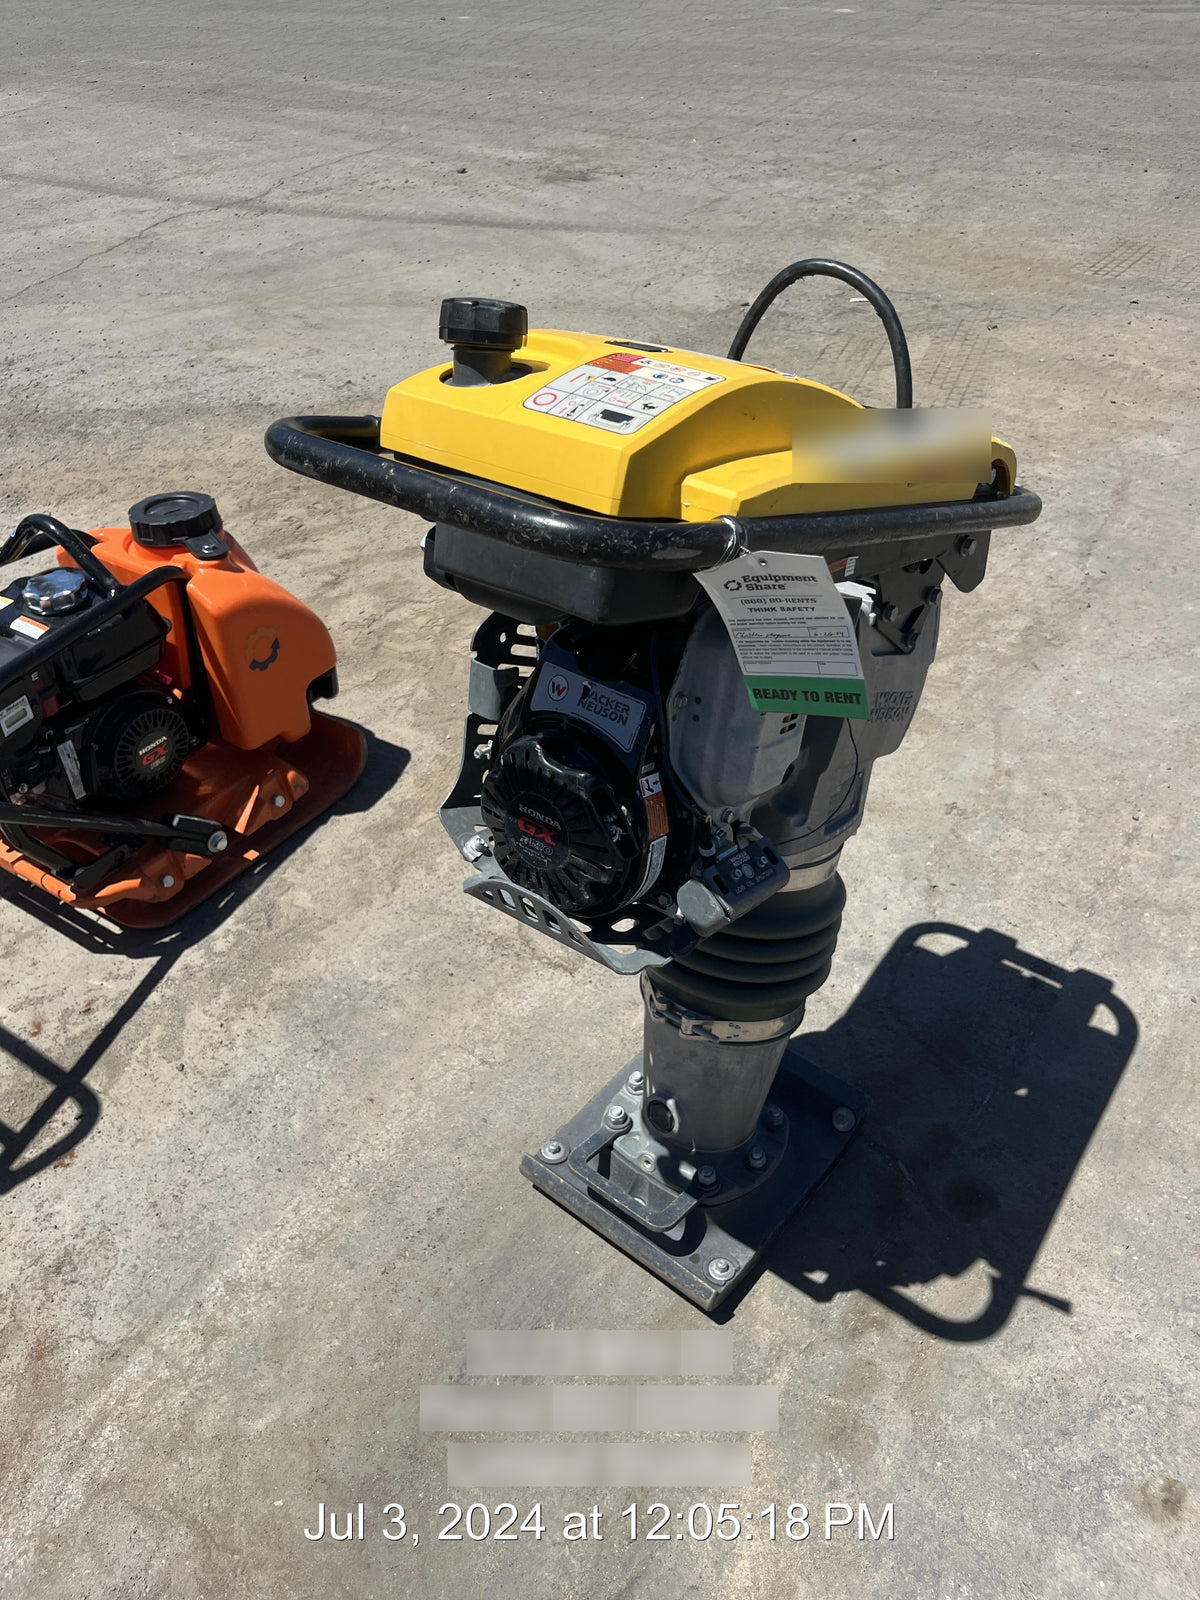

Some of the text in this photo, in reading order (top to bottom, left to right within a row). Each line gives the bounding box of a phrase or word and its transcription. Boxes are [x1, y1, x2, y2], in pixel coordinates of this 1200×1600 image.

[742, 573, 818, 584] Equipment
[745, 582, 786, 591] Share
[780, 605, 816, 613] SAFETY
[582, 686, 631, 716] ACKER
[752, 687, 862, 705] READY TO RENT
[576, 697, 630, 726] NEUSON
[138, 736, 168, 756] HONDA
[142, 742, 169, 766] GX
[518, 803, 562, 831] HONDA
[517, 817, 557, 846] GX
